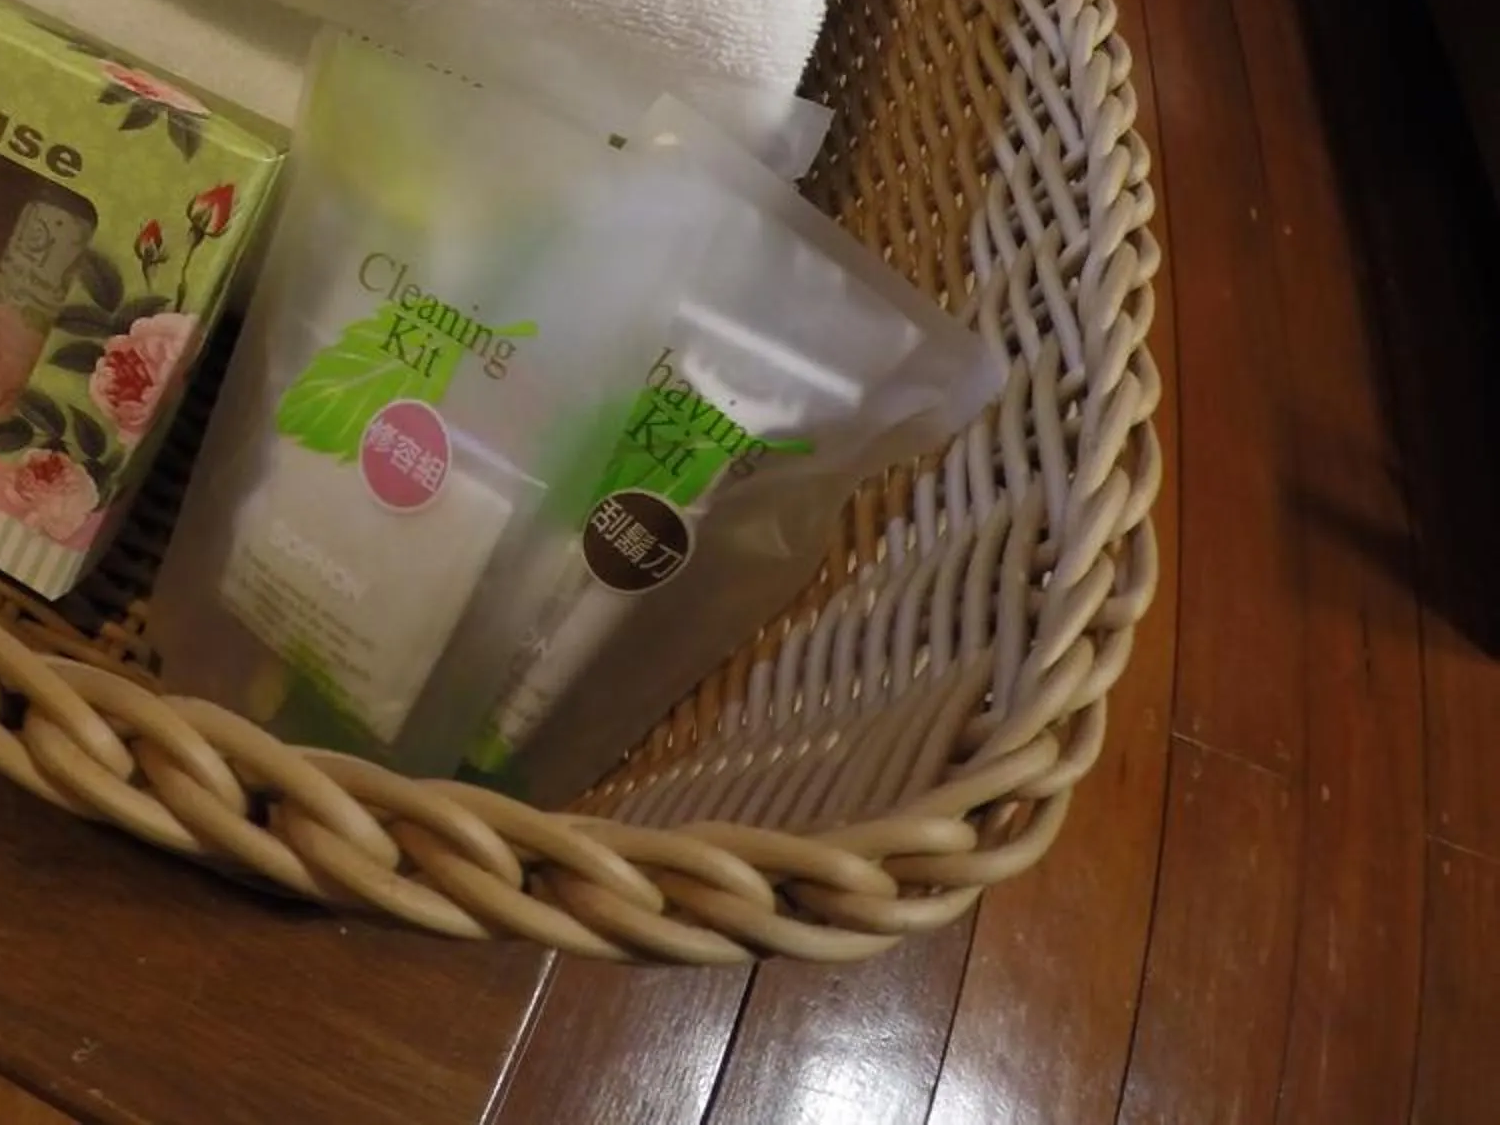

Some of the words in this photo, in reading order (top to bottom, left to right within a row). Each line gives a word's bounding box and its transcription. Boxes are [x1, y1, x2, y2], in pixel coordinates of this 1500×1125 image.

[357, 251, 517, 381] Cleaning
[379, 313, 441, 378] Kit
[626, 399, 697, 478] Kit
